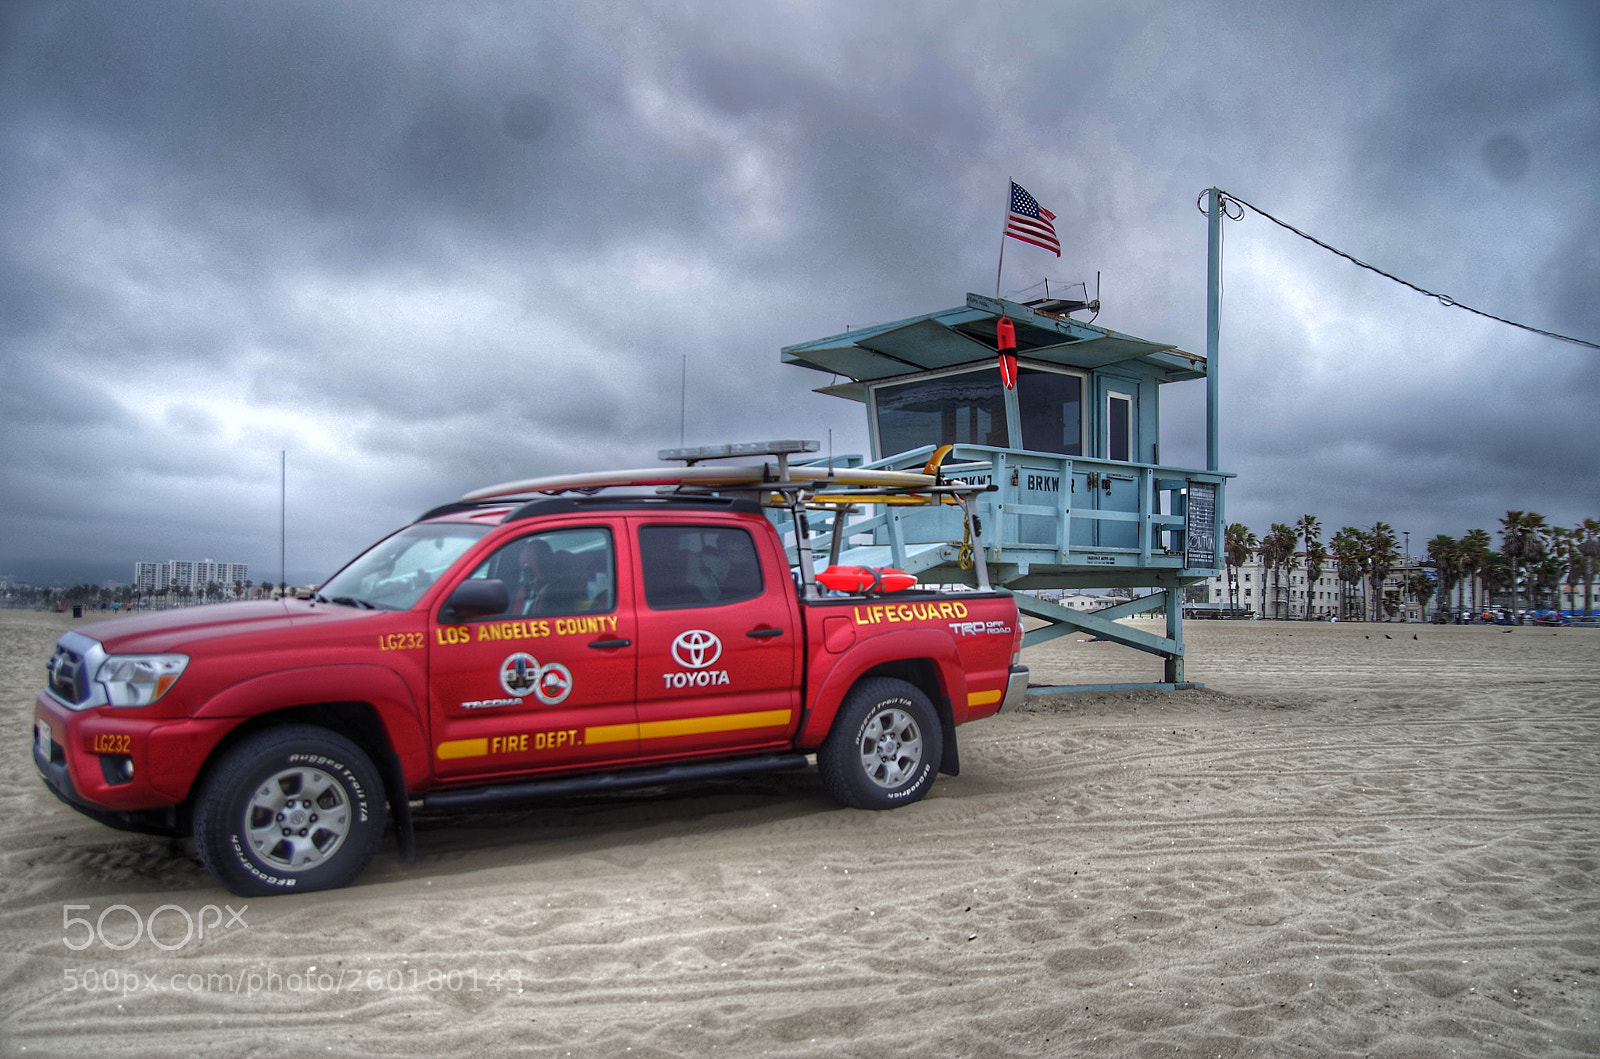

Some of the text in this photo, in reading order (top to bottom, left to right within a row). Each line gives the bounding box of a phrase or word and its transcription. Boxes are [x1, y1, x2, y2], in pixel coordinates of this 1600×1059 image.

[854, 602, 968, 625] LIFEGUARD
[436, 616, 618, 646] LOS ANGELES COUNTY
[949, 621, 985, 637] TRD
[379, 633, 425, 650] LG232
[663, 670, 730, 689] TOYOTA
[460, 698, 524, 710] TACOMA
[94, 735, 131, 752] LG232
[492, 729, 583, 754] FIRE DEPT.
